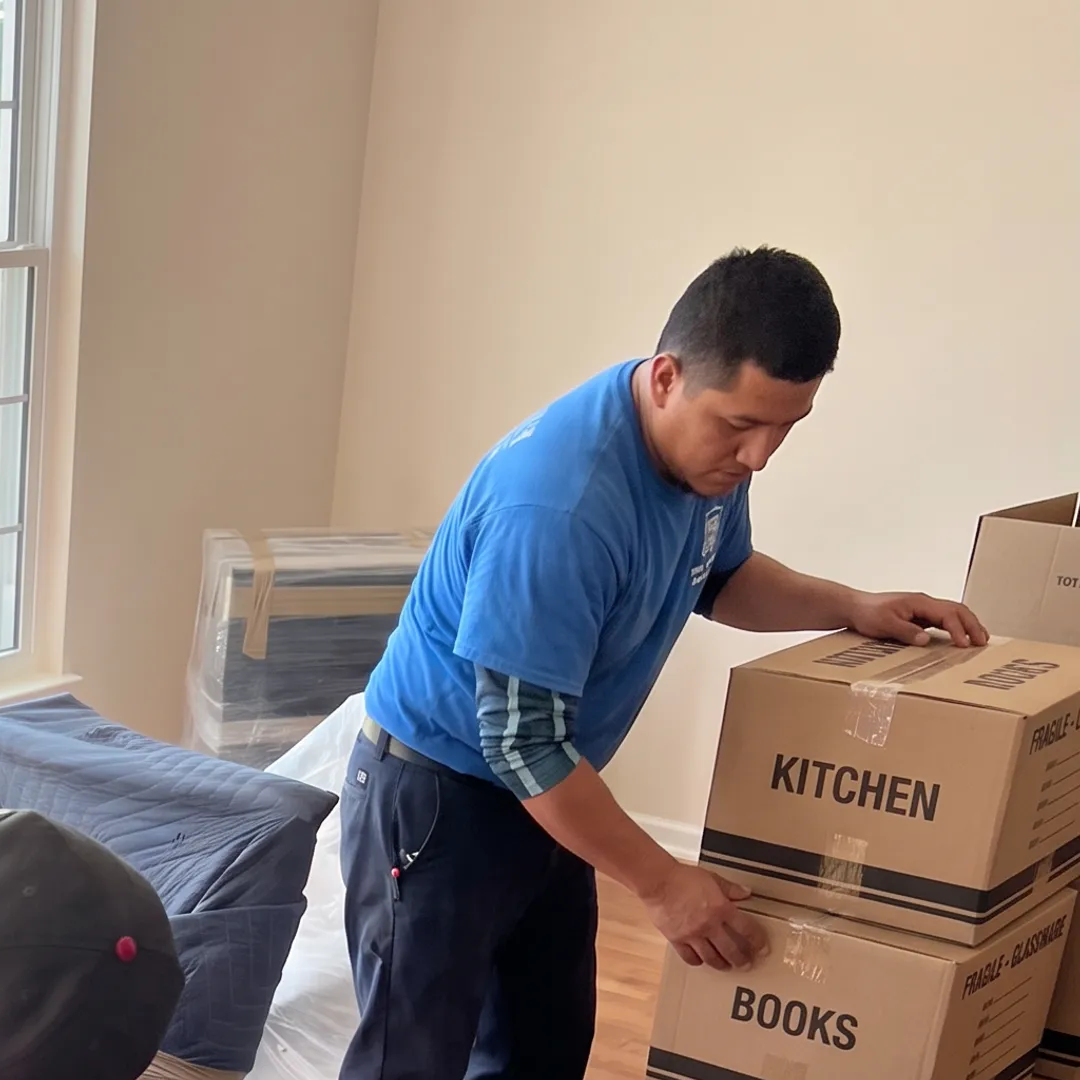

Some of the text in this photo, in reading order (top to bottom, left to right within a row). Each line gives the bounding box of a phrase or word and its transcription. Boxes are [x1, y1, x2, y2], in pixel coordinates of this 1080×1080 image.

[1056, 575, 1080, 589] TOT
[770, 753, 941, 822] KITCHEN
[731, 985, 859, 1051] BOOKS
